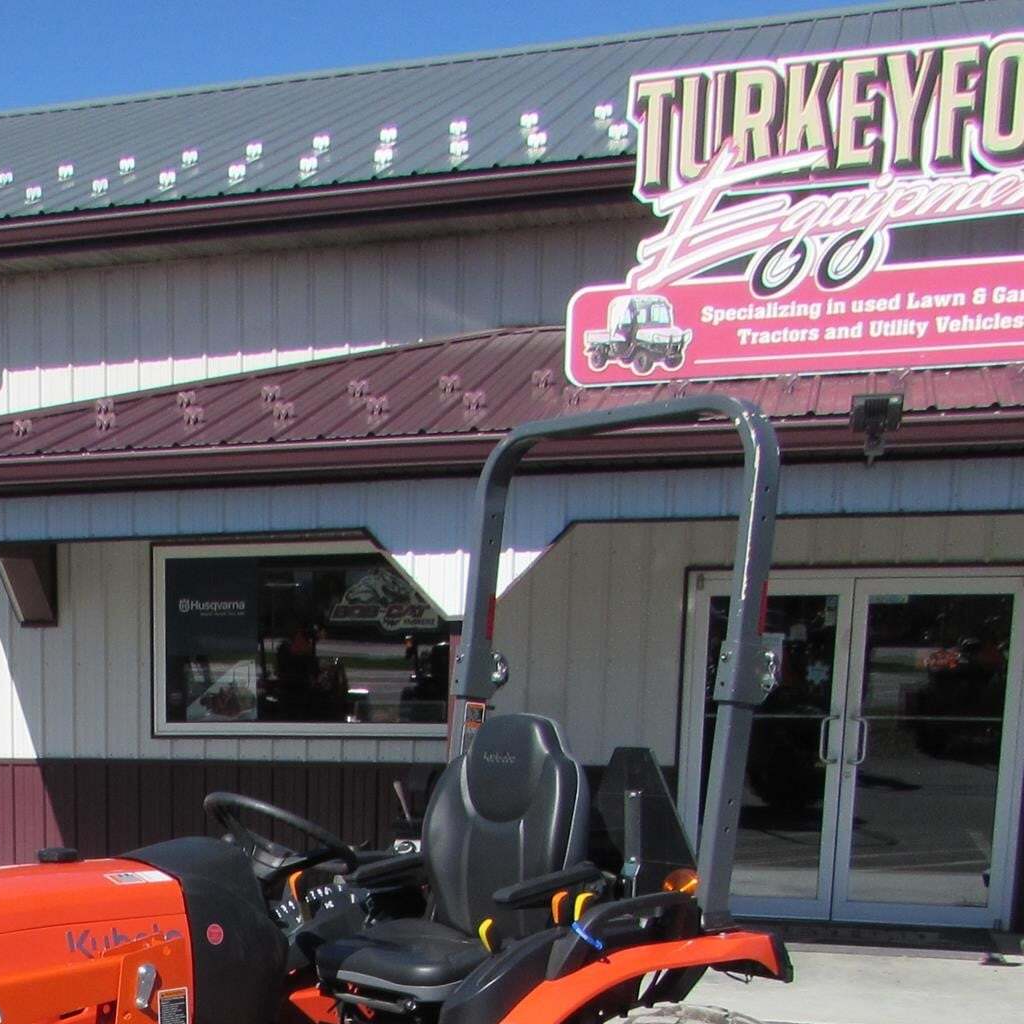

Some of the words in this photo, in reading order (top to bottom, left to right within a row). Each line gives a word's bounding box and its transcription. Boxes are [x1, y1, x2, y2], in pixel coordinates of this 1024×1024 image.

[700, 300, 822, 326] Specializing
[827, 298, 845, 316] in
[851, 293, 901, 314] used
[906, 289, 965, 310] Lawn
[972, 287, 987, 305] &
[737, 325, 819, 345] Tractors
[824, 321, 863, 340] and
[869, 317, 928, 338] Utility
[935, 312, 1024, 333] Vehicles
[190, 600, 245, 612] Husqvarna
